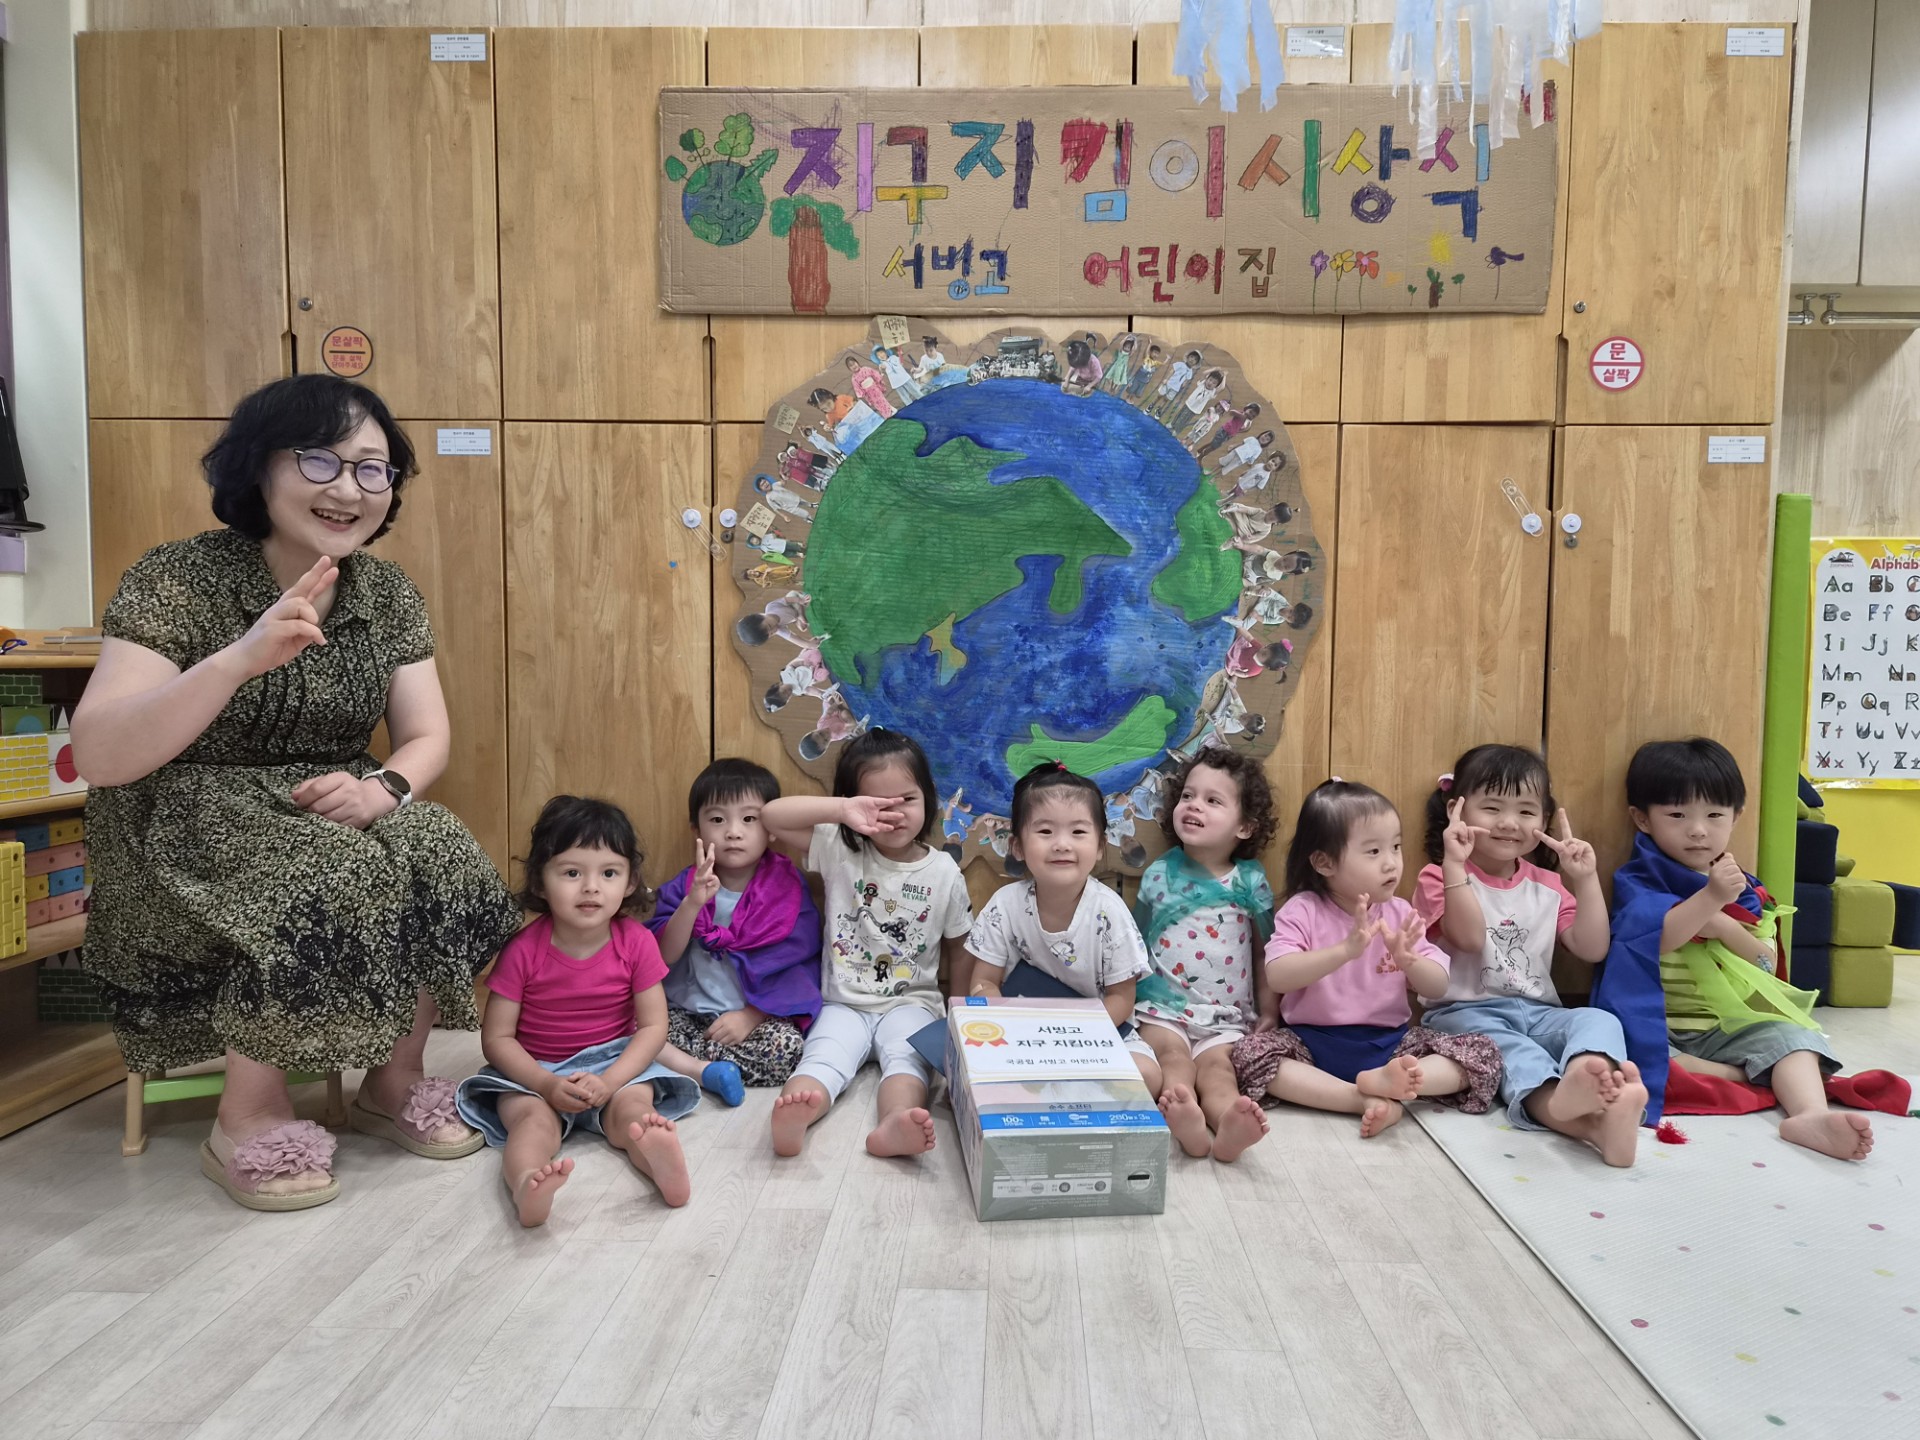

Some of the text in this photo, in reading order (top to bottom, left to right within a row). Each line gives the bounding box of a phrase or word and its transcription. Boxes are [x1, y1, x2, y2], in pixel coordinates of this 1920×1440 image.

[1083, 244, 1276, 303] 어린이집
[1610, 343, 1626, 360] 문
[1871, 558, 1920, 571] Alphab
[1824, 575, 1853, 593] Aa
[1869, 575, 1894, 593] Bb
[1868, 604, 1894, 621] Ff
[1861, 633, 1888, 656] Jj
[1822, 663, 1916, 681] Mm Nn
[1821, 692, 1847, 716] Pp
[1861, 692, 1890, 716] Qq
[1818, 721, 1843, 739] Tt
[1856, 721, 1884, 740] Uu
[1816, 751, 1844, 768] Xx
[1857, 751, 1879, 777] Yy
[902, 892, 928, 903] NEVADA
[1038, 1026, 1083, 1034] 서빙고
[1016, 1039, 1114, 1047] 지구 지킴이상
